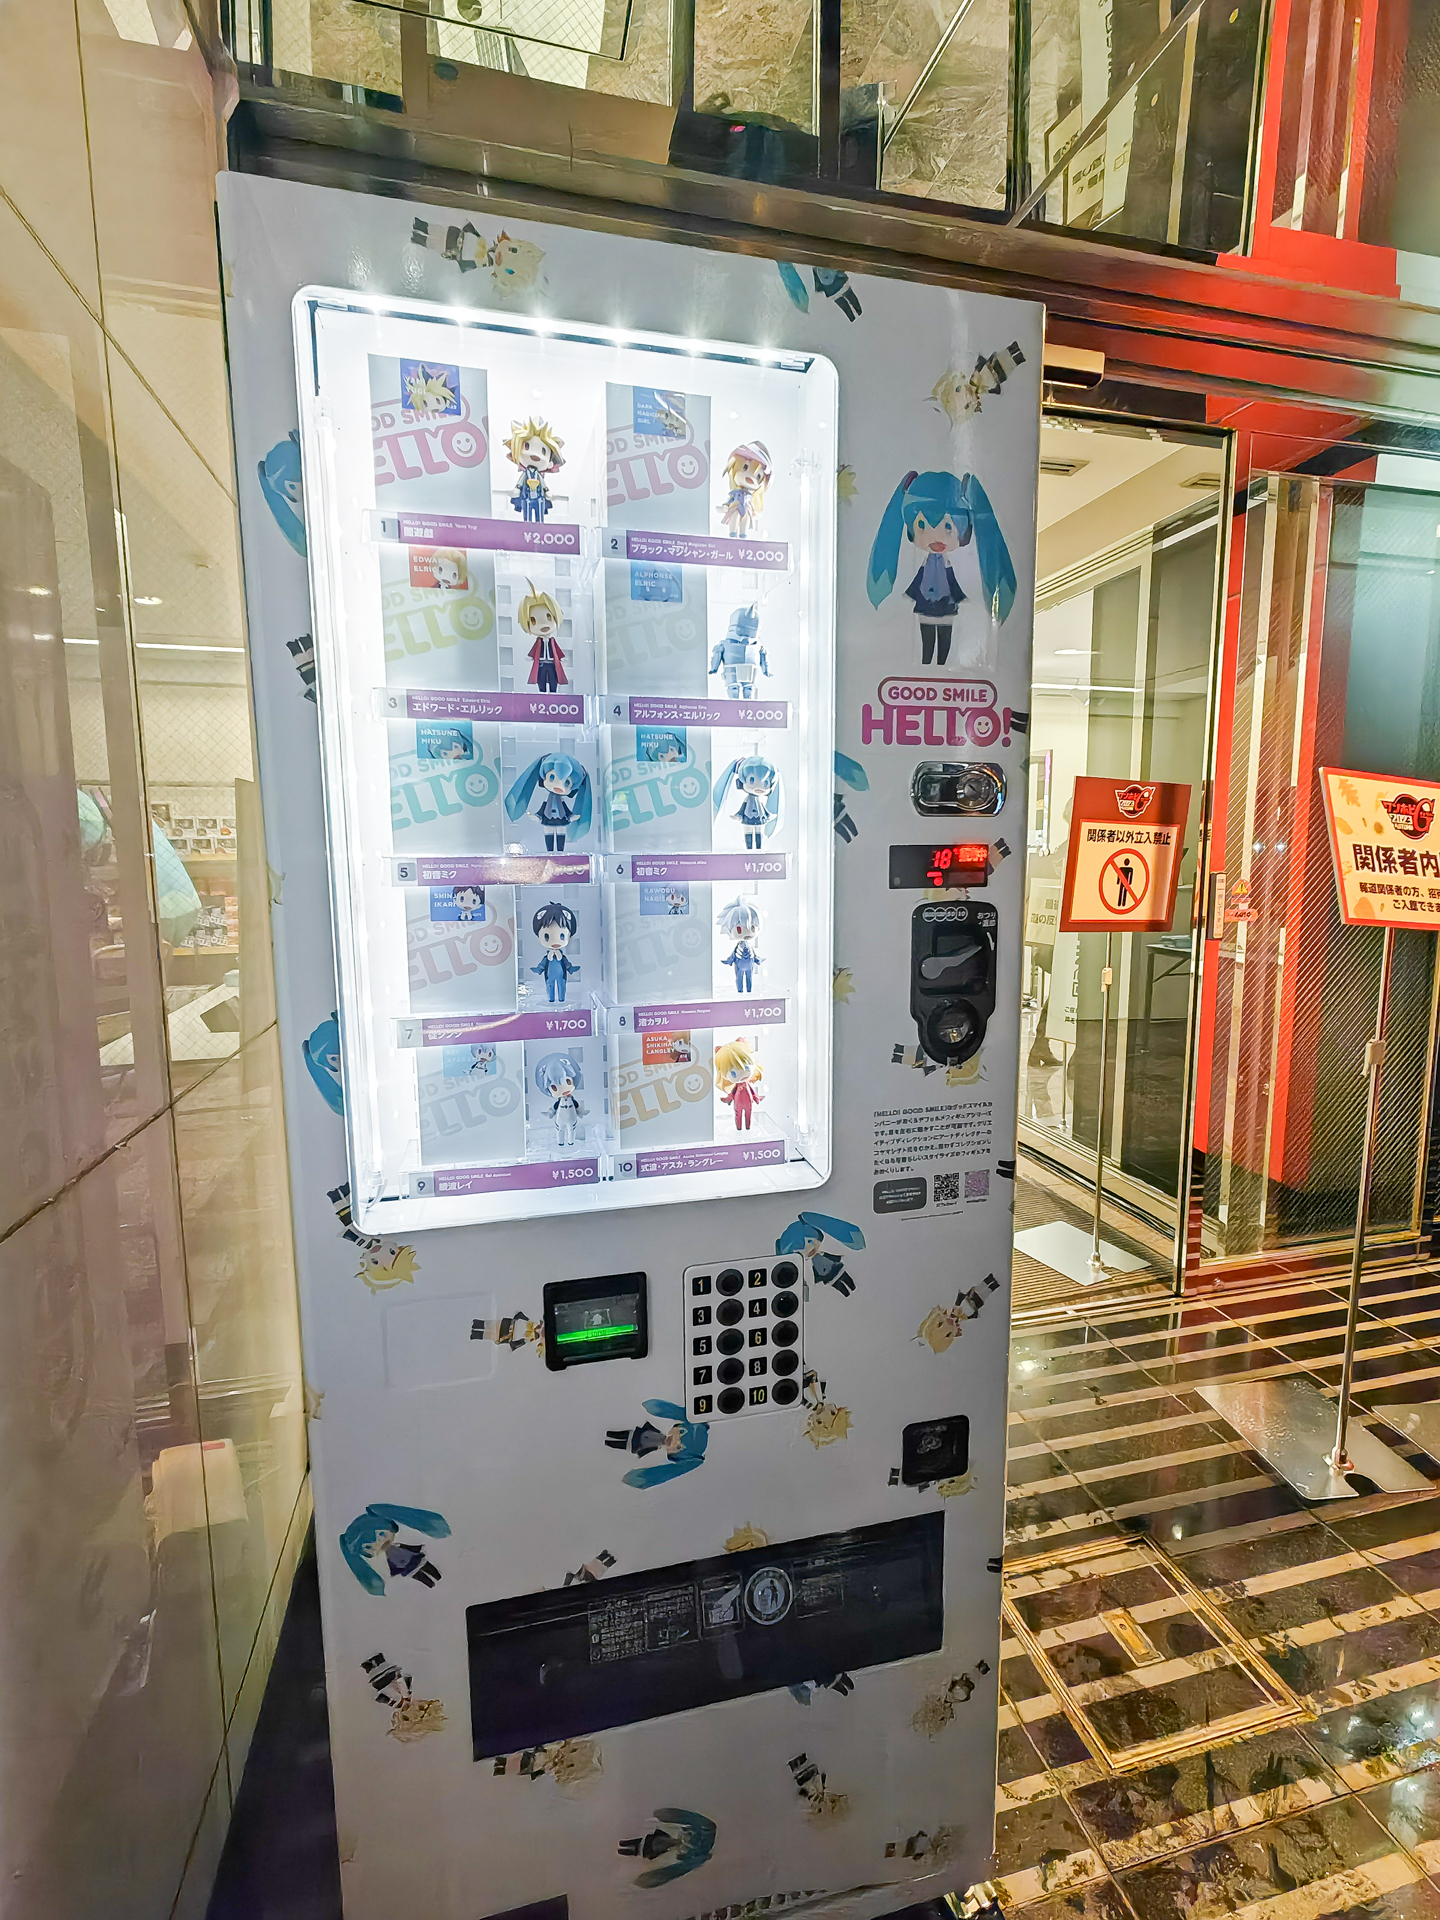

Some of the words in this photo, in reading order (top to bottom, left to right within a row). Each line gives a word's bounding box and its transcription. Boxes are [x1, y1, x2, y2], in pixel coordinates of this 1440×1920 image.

[381, 520, 385, 532] 1
[523, 531, 574, 546] ¥2,000
[610, 538, 618, 549] 2
[738, 549, 783, 562] ¥2,000
[888, 686, 938, 700] GOOD
[942, 688, 988, 702] SMILE
[389, 697, 396, 707] 3
[412, 702, 502, 714] エドワード・エルリック
[530, 703, 578, 715] ¥2,000
[613, 705, 621, 715] 4
[633, 710, 720, 720] アルフォンス・エルリック
[738, 709, 783, 720] ¥2,000
[861, 703, 1012, 748] HELLO!
[421, 728, 458, 736] HATSUNE
[1087, 829, 1171, 846] 関係者以外立入禁止
[744, 862, 781, 872] ¥1,700
[1352, 844, 1440, 878] 関係者内
[400, 867, 408, 877] 5
[422, 870, 456, 879] 初音ミク
[615, 864, 624, 874] 6
[636, 867, 667, 875] 初音ミク
[977, 912, 996, 920] おつり
[744, 1007, 781, 1018] ¥1,700
[546, 1018, 586, 1031] ¥1,700
[618, 1016, 626, 1026] 8
[406, 1028, 412, 1039] 7
[742, 1148, 780, 1161] ¥1,500
[618, 1162, 632, 1172] 10
[552, 1167, 593, 1180] ¥1,500
[417, 1181, 426, 1191] 9
[754, 1272, 761, 1286] 2
[698, 1279, 704, 1293] 1
[753, 1301, 760, 1315] 4
[698, 1309, 705, 1323] 3
[754, 1331, 762, 1345] 6
[700, 1339, 707, 1353] 5
[754, 1361, 761, 1374] 8
[699, 1369, 706, 1383] 7
[752, 1389, 765, 1403] 10
[699, 1399, 706, 1412] 9
